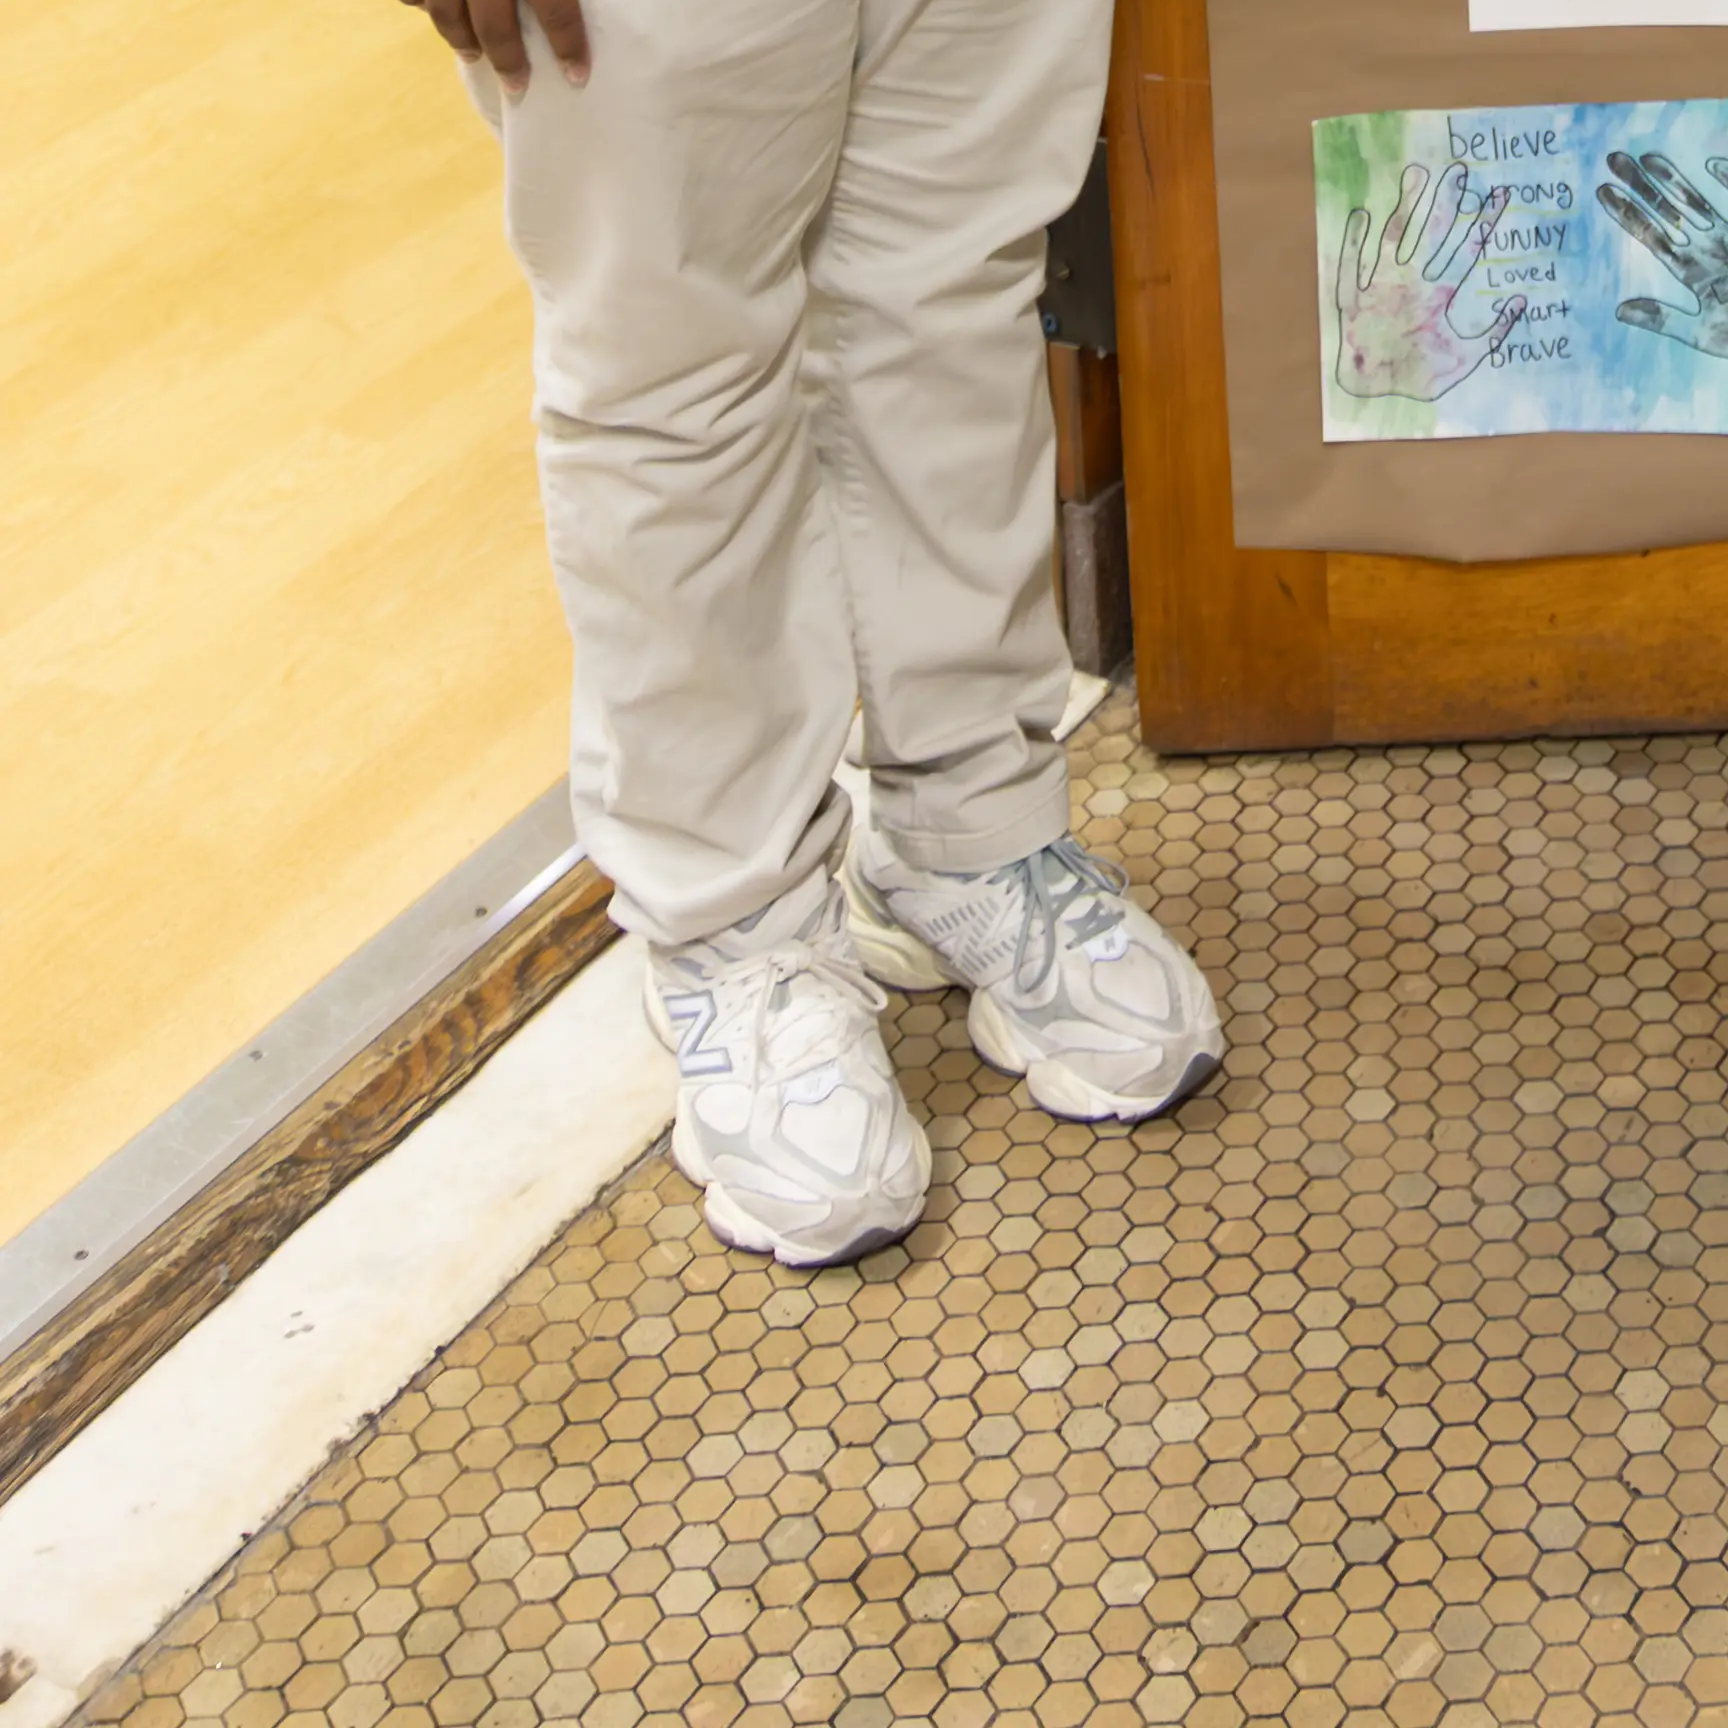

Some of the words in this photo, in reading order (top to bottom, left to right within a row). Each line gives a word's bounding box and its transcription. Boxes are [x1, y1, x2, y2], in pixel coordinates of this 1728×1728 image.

[1446, 114, 1562, 162] believe
[1487, 261, 1557, 288] Loved
[1488, 335, 1573, 370] Brave
